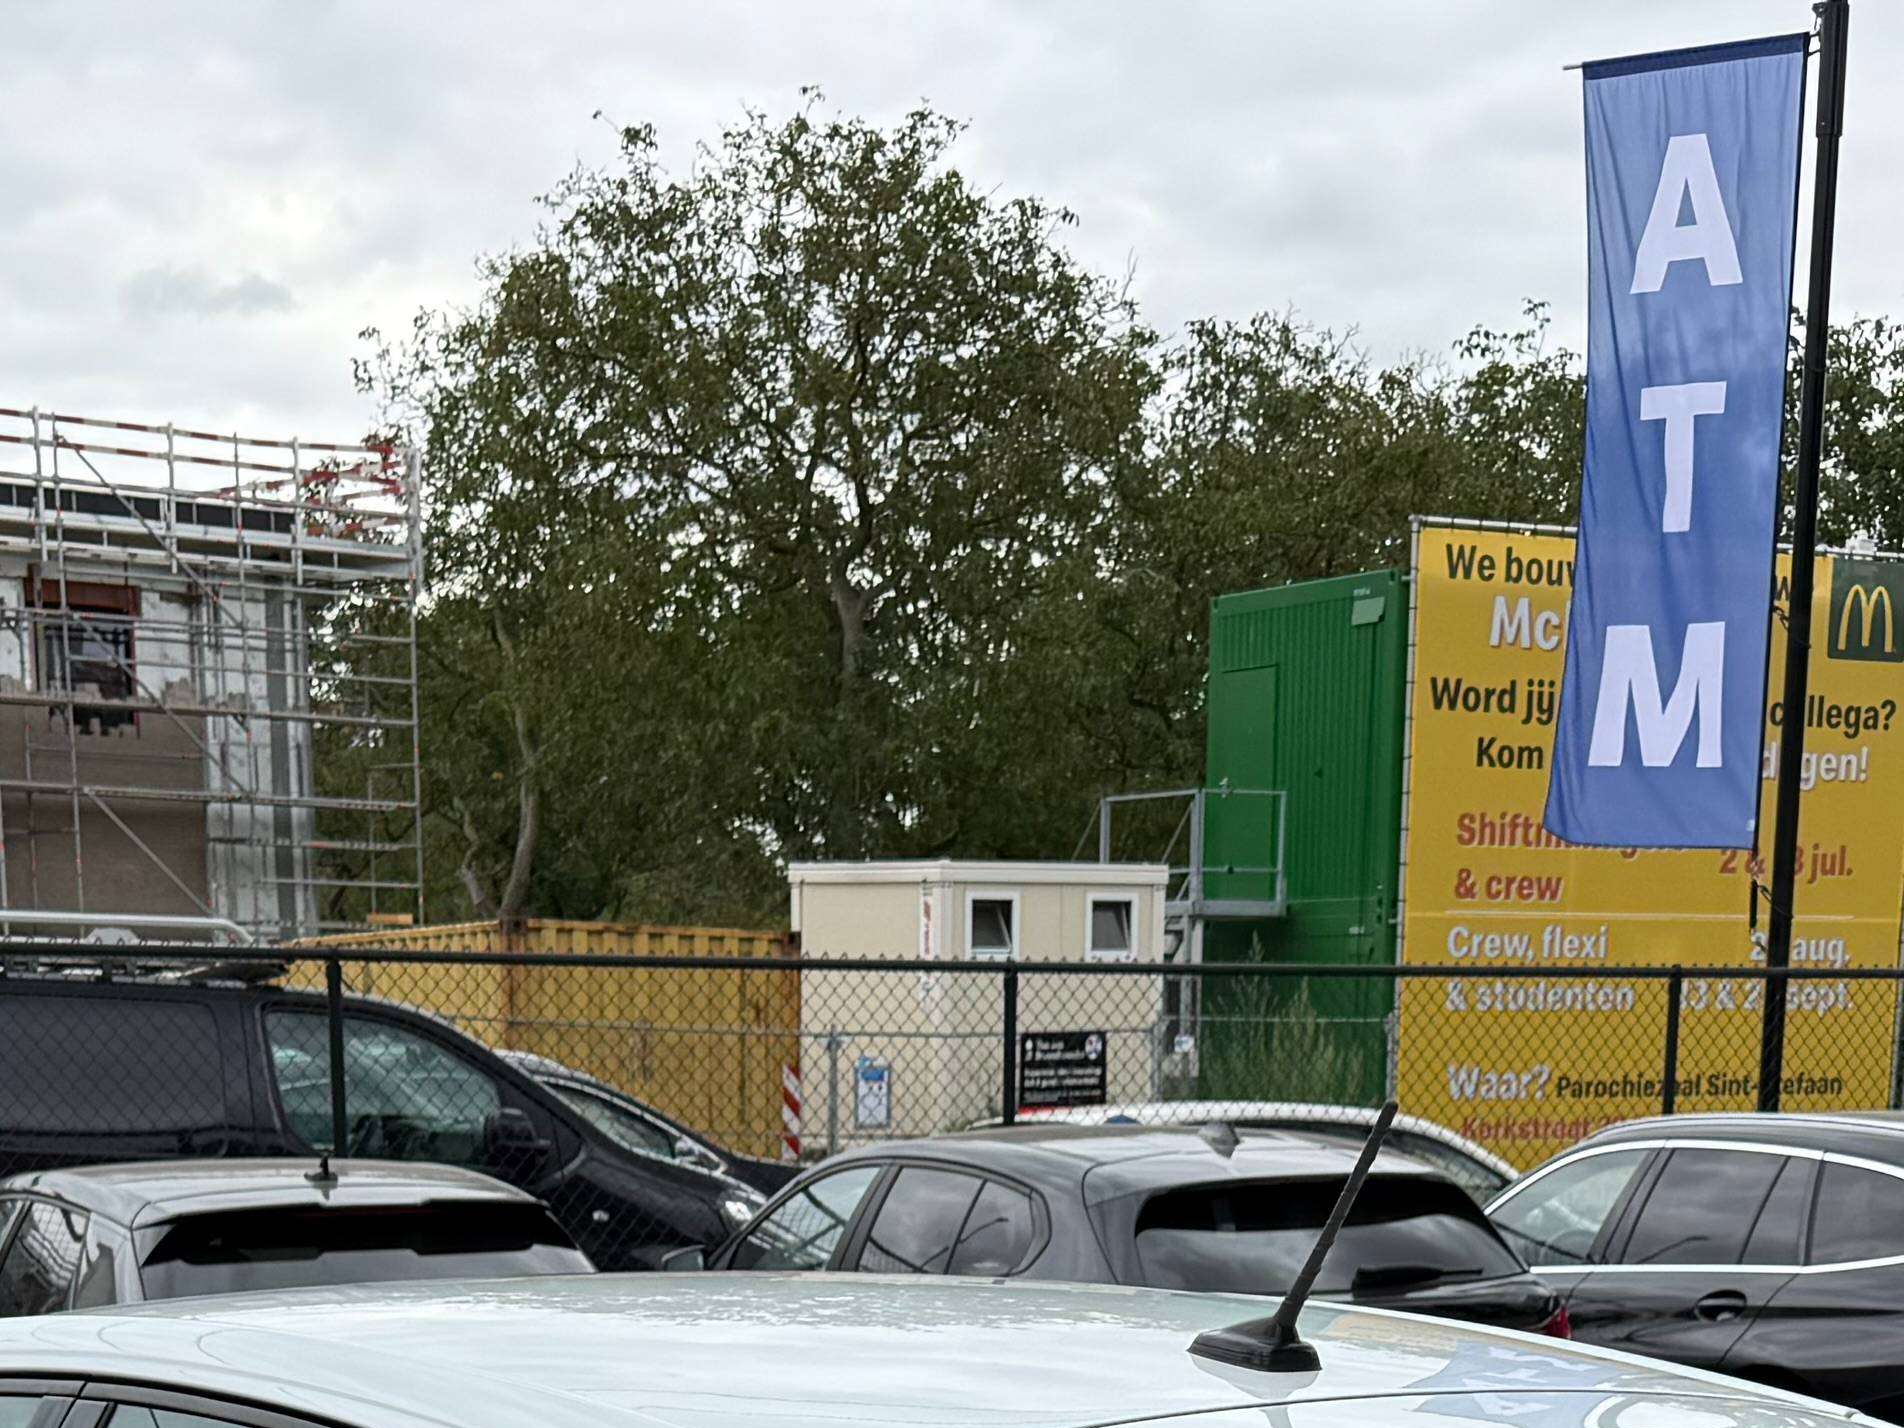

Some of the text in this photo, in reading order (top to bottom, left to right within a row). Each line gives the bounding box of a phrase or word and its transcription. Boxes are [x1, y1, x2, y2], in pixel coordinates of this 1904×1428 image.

[1445, 543, 1496, 582] We
[1489, 596, 1571, 650] Mc
[1430, 676, 1896, 738] Word jij cllega?
[1476, 736, 1868, 790] Kom dgen!
[1808, 843, 1854, 884] jul.
[1454, 868, 1564, 902] & crew
[1447, 926, 1535, 962] Crew,
[1542, 925, 1609, 959] flexi
[1791, 936, 1852, 969] aug.
[1476, 980, 1636, 1013] studenten
[1447, 1063, 1552, 1101] Waar?
[1706, 1072, 1843, 1097] Sint-efaan
